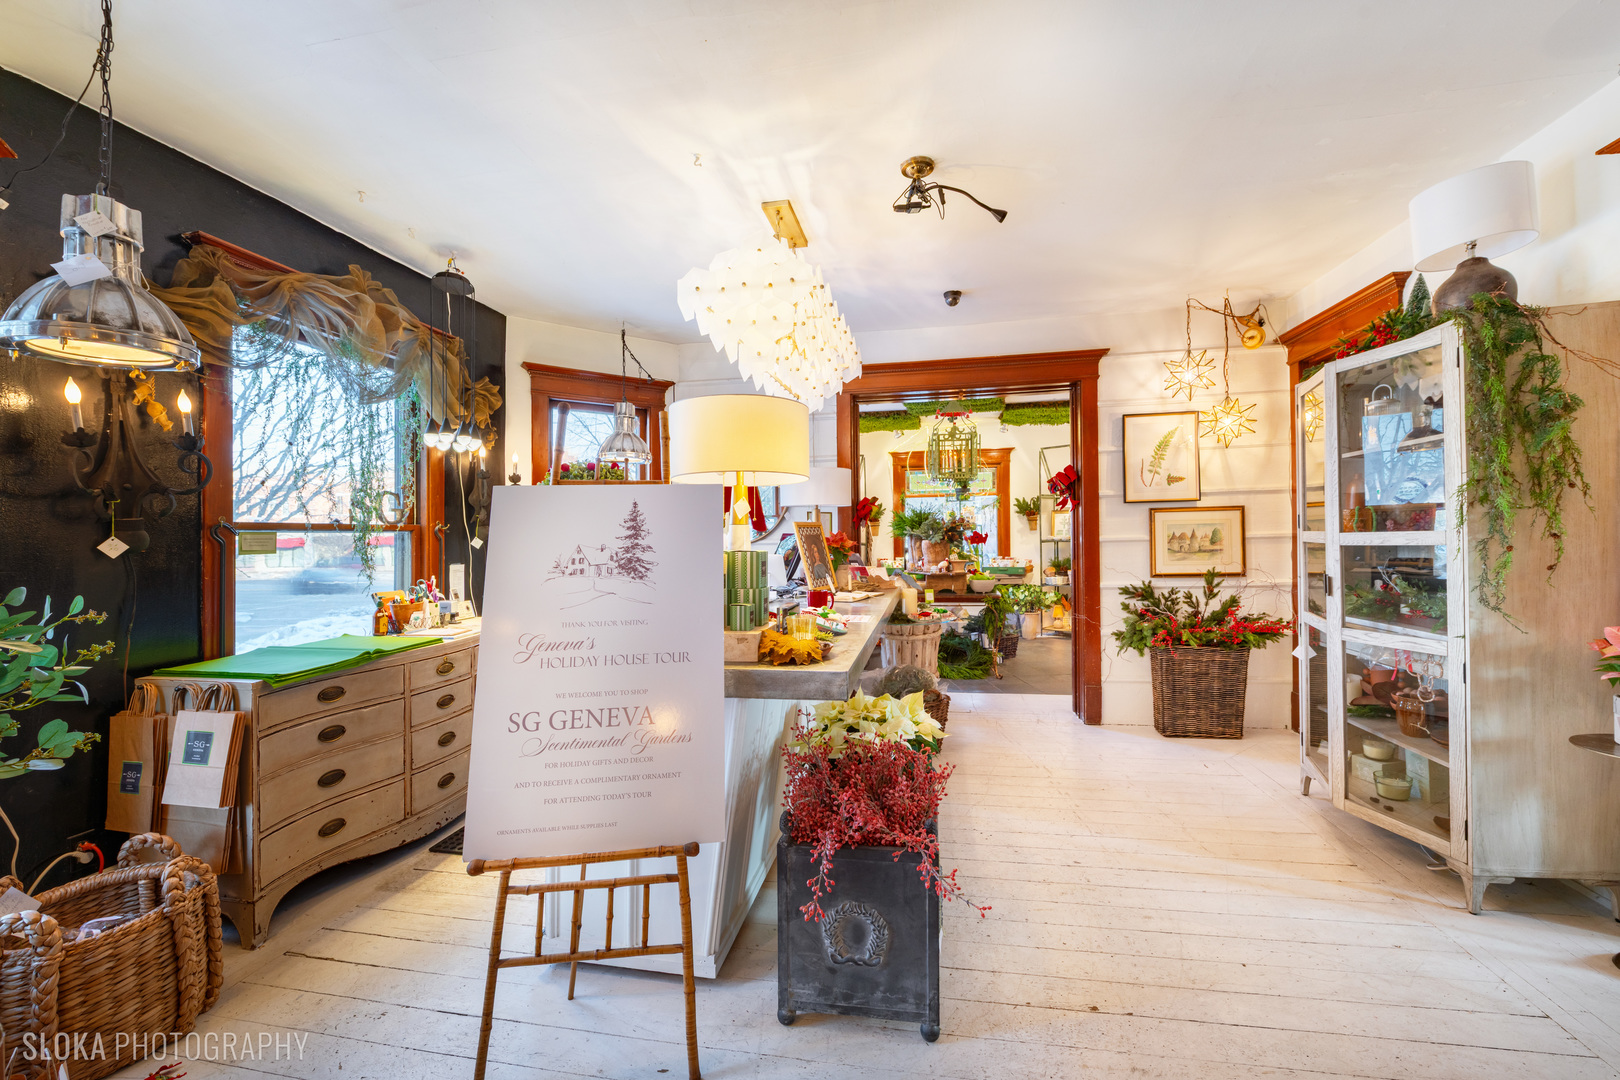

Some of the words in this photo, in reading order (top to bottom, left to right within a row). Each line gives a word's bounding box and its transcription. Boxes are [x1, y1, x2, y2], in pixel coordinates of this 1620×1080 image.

[513, 633, 597, 664] Geneva's
[540, 655, 599, 670] HOLIDAY
[605, 653, 649, 667] HOUSE
[653, 651, 692, 664] TOUR
[568, 690, 602, 698] WELCOME
[508, 711, 540, 733] SG
[549, 706, 655, 731] GENEVA
[518, 732, 632, 758] Scentimental
[630, 729, 694, 755] Gardens
[560, 760, 591, 768] HOLIDAY
[592, 759, 612, 767] GIFTS
[543, 779, 573, 787] RECEIVE
[581, 775, 641, 784] COMPLIMENTARY
[642, 772, 682, 780] ORNAMENT
[559, 795, 601, 804] ATTENDING
[602, 793, 631, 802] TODAY'S
